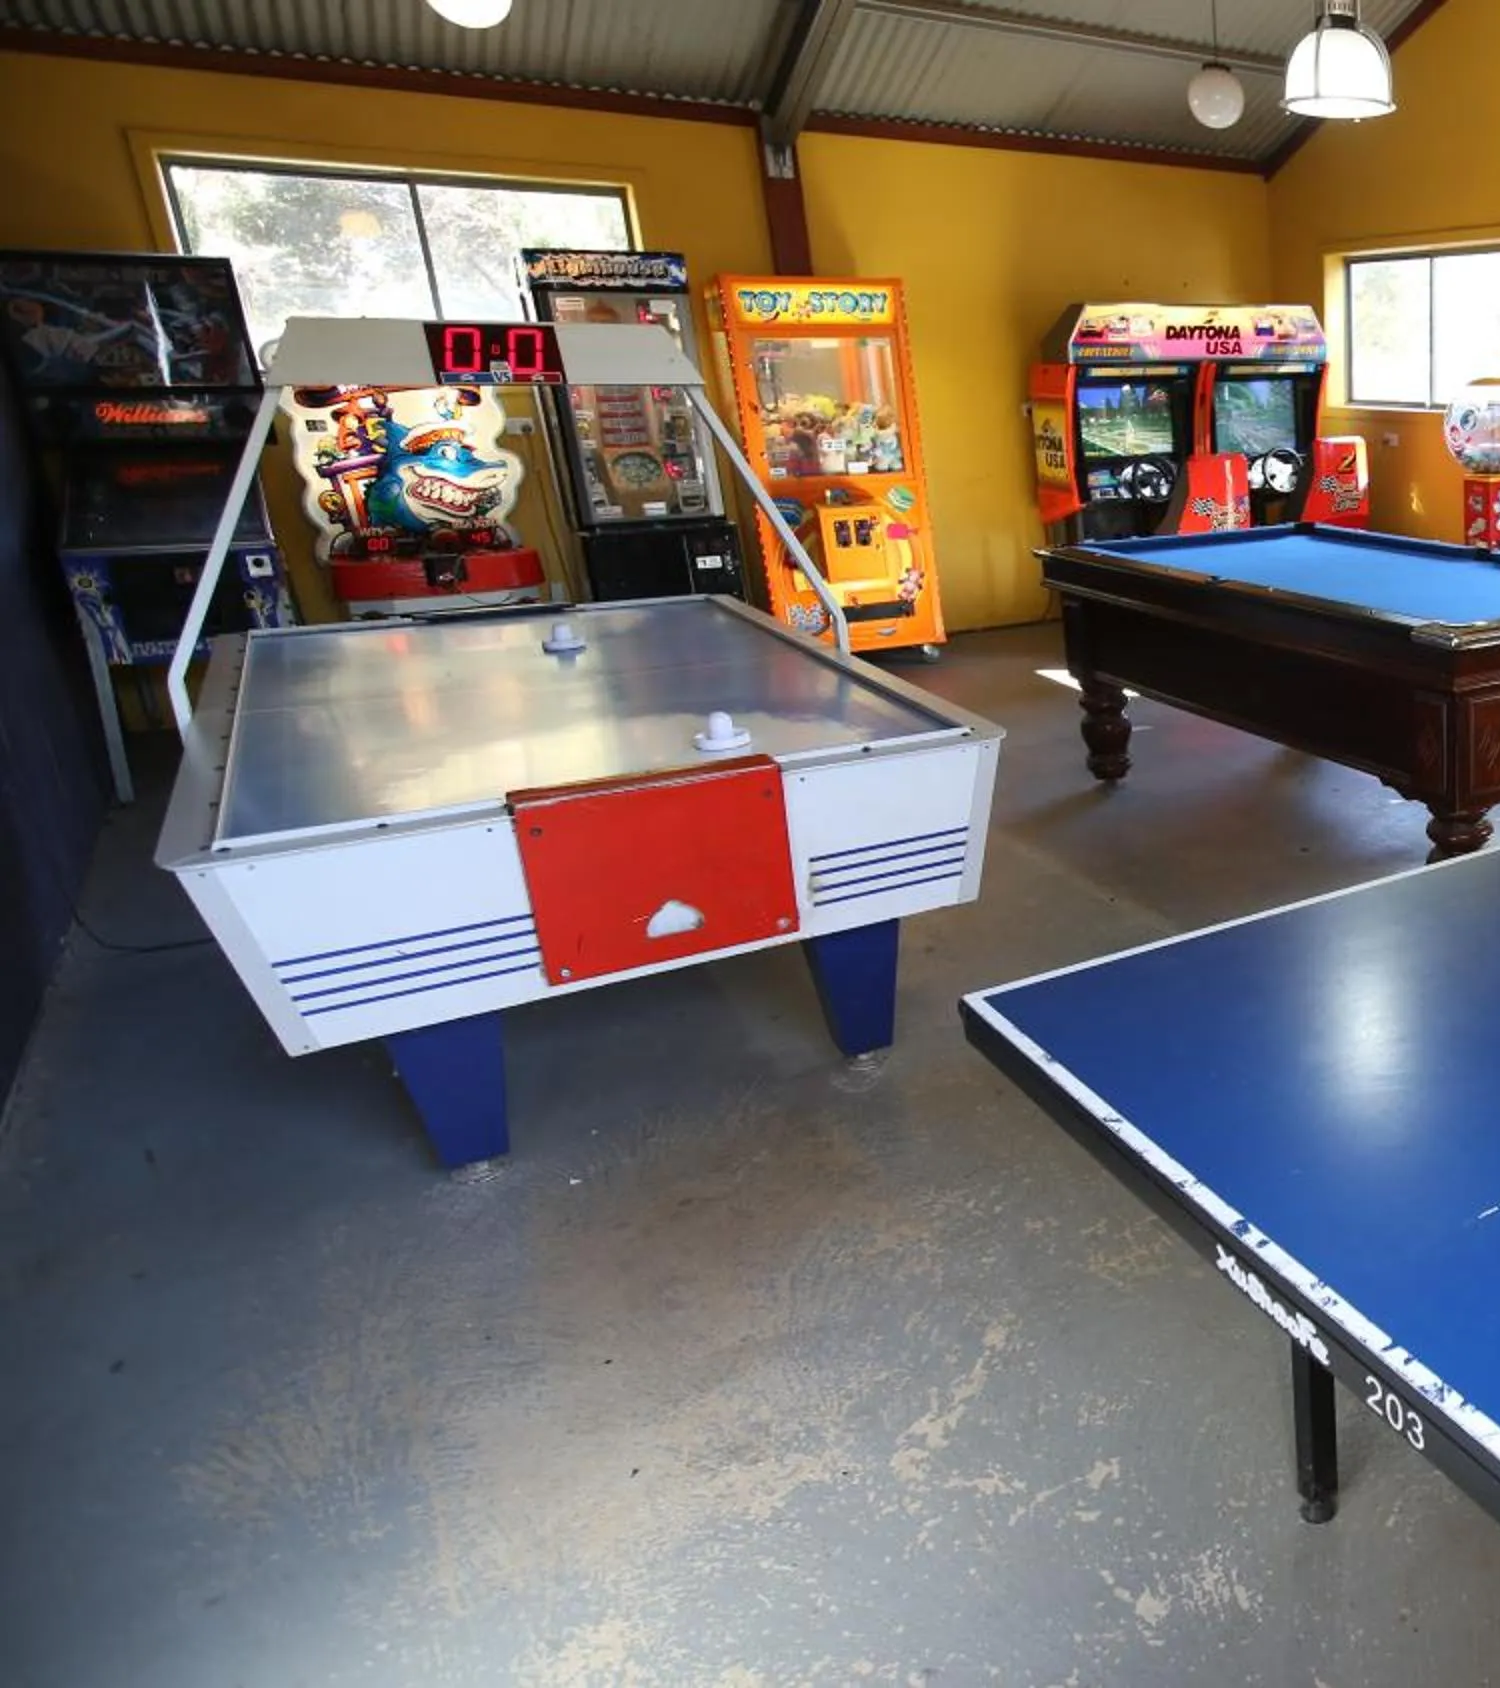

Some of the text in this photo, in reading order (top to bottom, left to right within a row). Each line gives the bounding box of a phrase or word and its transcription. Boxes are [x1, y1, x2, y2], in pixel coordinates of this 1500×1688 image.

[738, 290, 888, 314] TOY STORY
[1165, 324, 1241, 341] DAYTONA
[445, 327, 543, 372] 0 0
[1205, 341, 1243, 356] USA
[95, 401, 208, 424] Williams
[1364, 1375, 1425, 1450] 203
